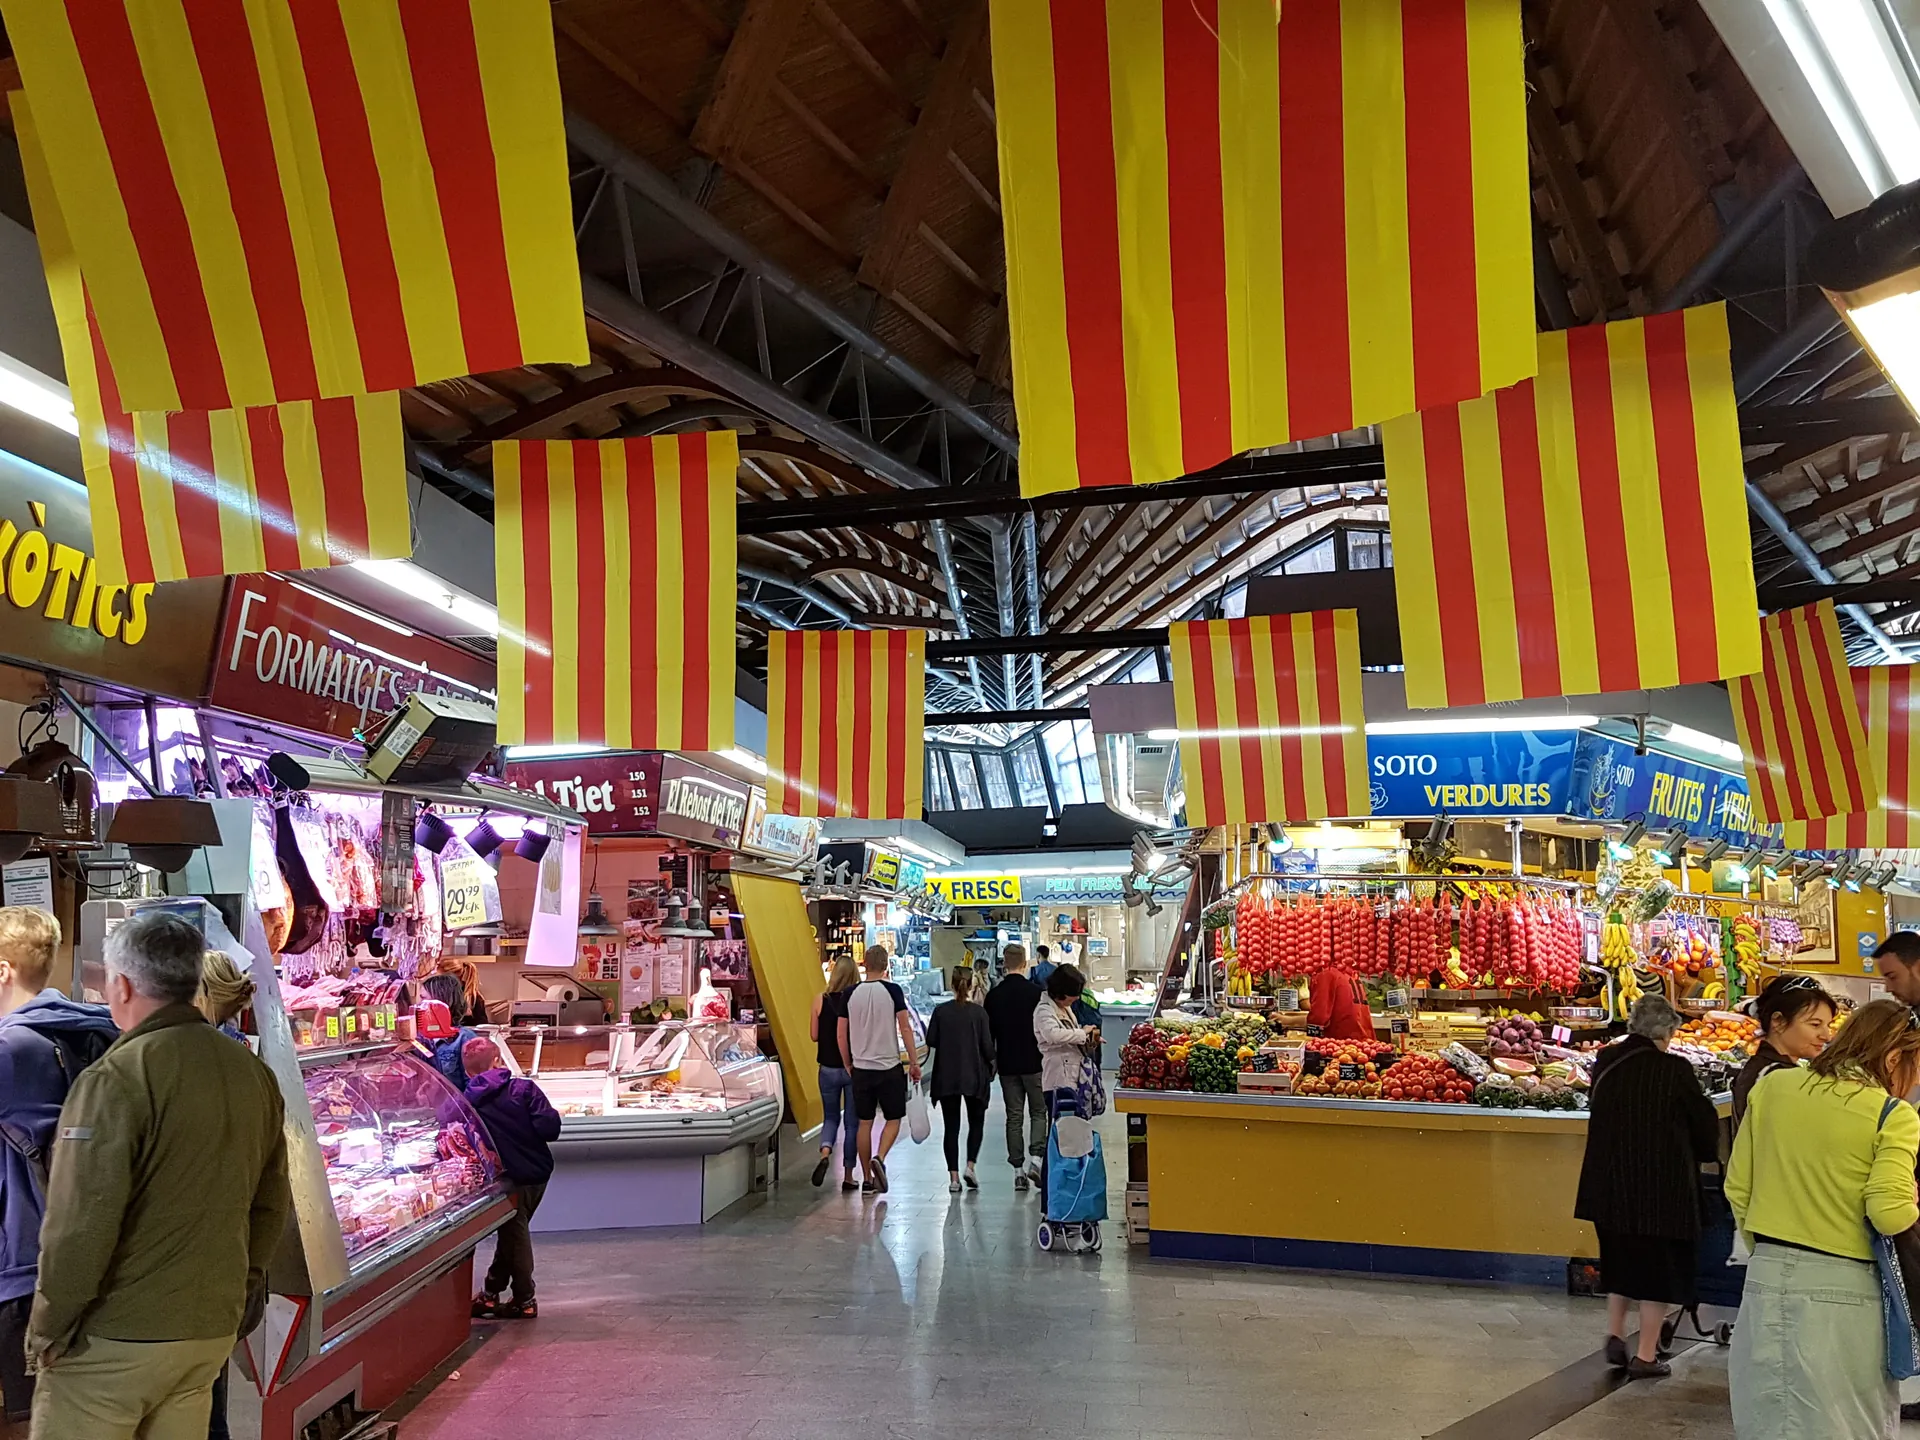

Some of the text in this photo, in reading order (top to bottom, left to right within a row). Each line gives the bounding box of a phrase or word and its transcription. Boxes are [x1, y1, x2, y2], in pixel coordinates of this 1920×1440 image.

[629, 771, 646, 781] 150
[1374, 754, 1437, 777] SOTO
[1615, 763, 1635, 788] SOTO
[553, 776, 616, 812] Tiet
[631, 789, 648, 799] 151
[1424, 783, 1551, 807] VERDURES
[1648, 771, 1706, 823] FRUITES
[1708, 784, 1718, 826] i
[633, 806, 650, 816] 152
[666, 780, 744, 831] El Rebost del Tiet
[951, 880, 1013, 900] FRESC
[1046, 877, 1076, 892] PEIX
[1080, 876, 1123, 891] FRESC
[577, 971, 596, 980] 2017
